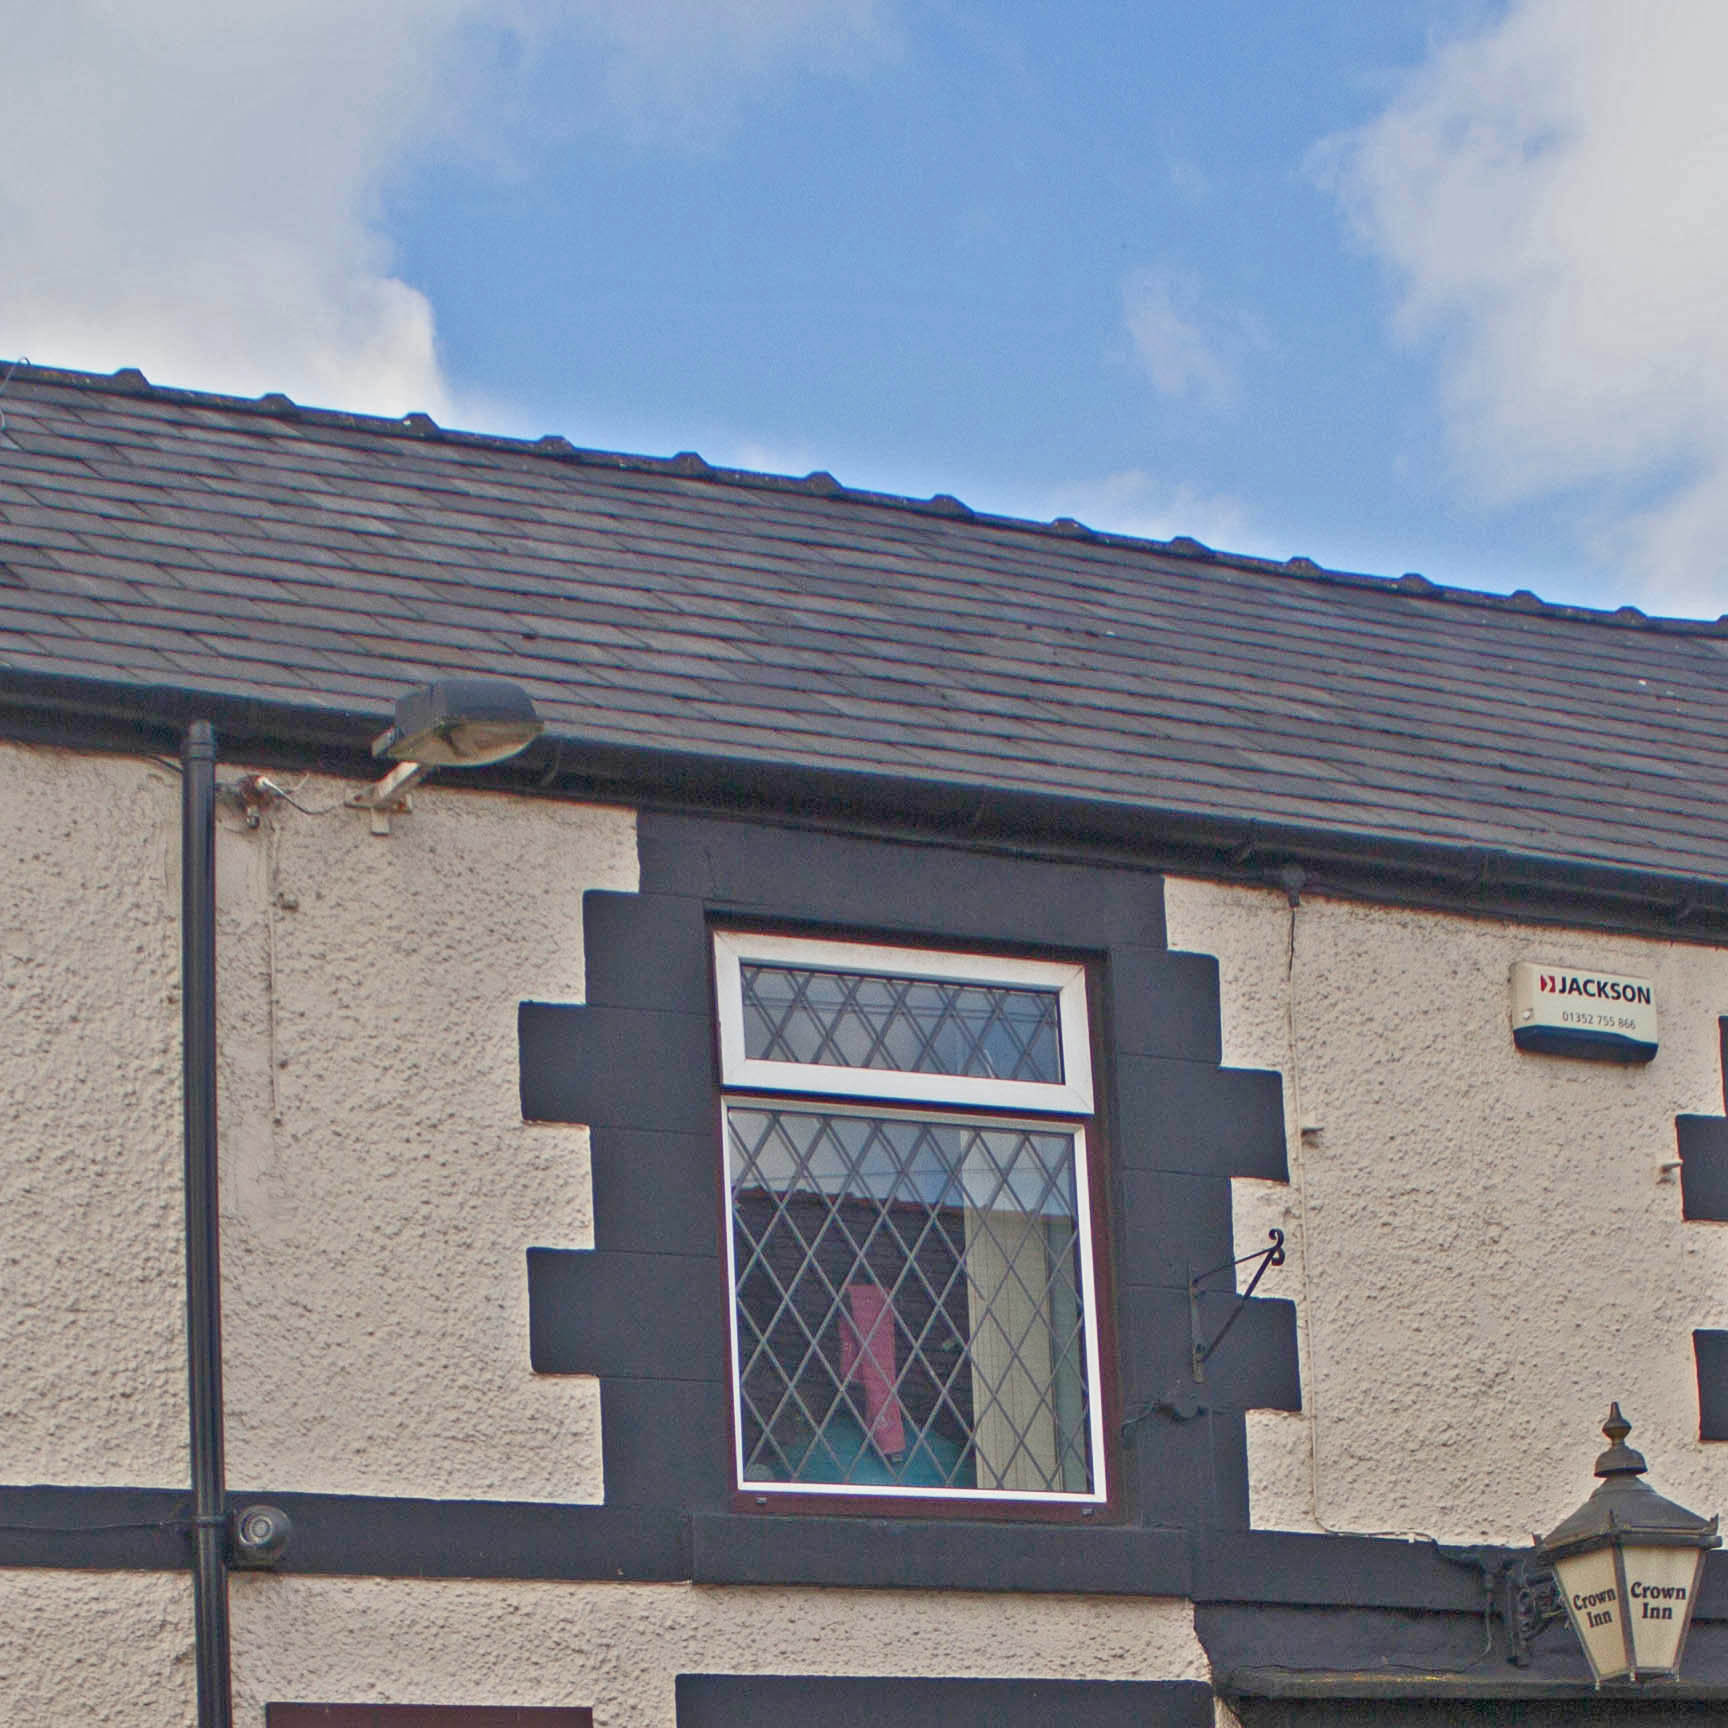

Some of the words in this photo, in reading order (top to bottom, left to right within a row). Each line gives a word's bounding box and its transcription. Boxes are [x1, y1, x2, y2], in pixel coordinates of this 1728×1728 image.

[1558, 975, 1652, 1005] JACKSON
[1561, 1010, 1594, 1025] 01352
[1596, 1013, 1616, 1027] 755
[1572, 1587, 1617, 1611] Crown
[1630, 1581, 1687, 1601] Crown
[1586, 1610, 1613, 1628] Inn
[1641, 1602, 1673, 1620] Inn
